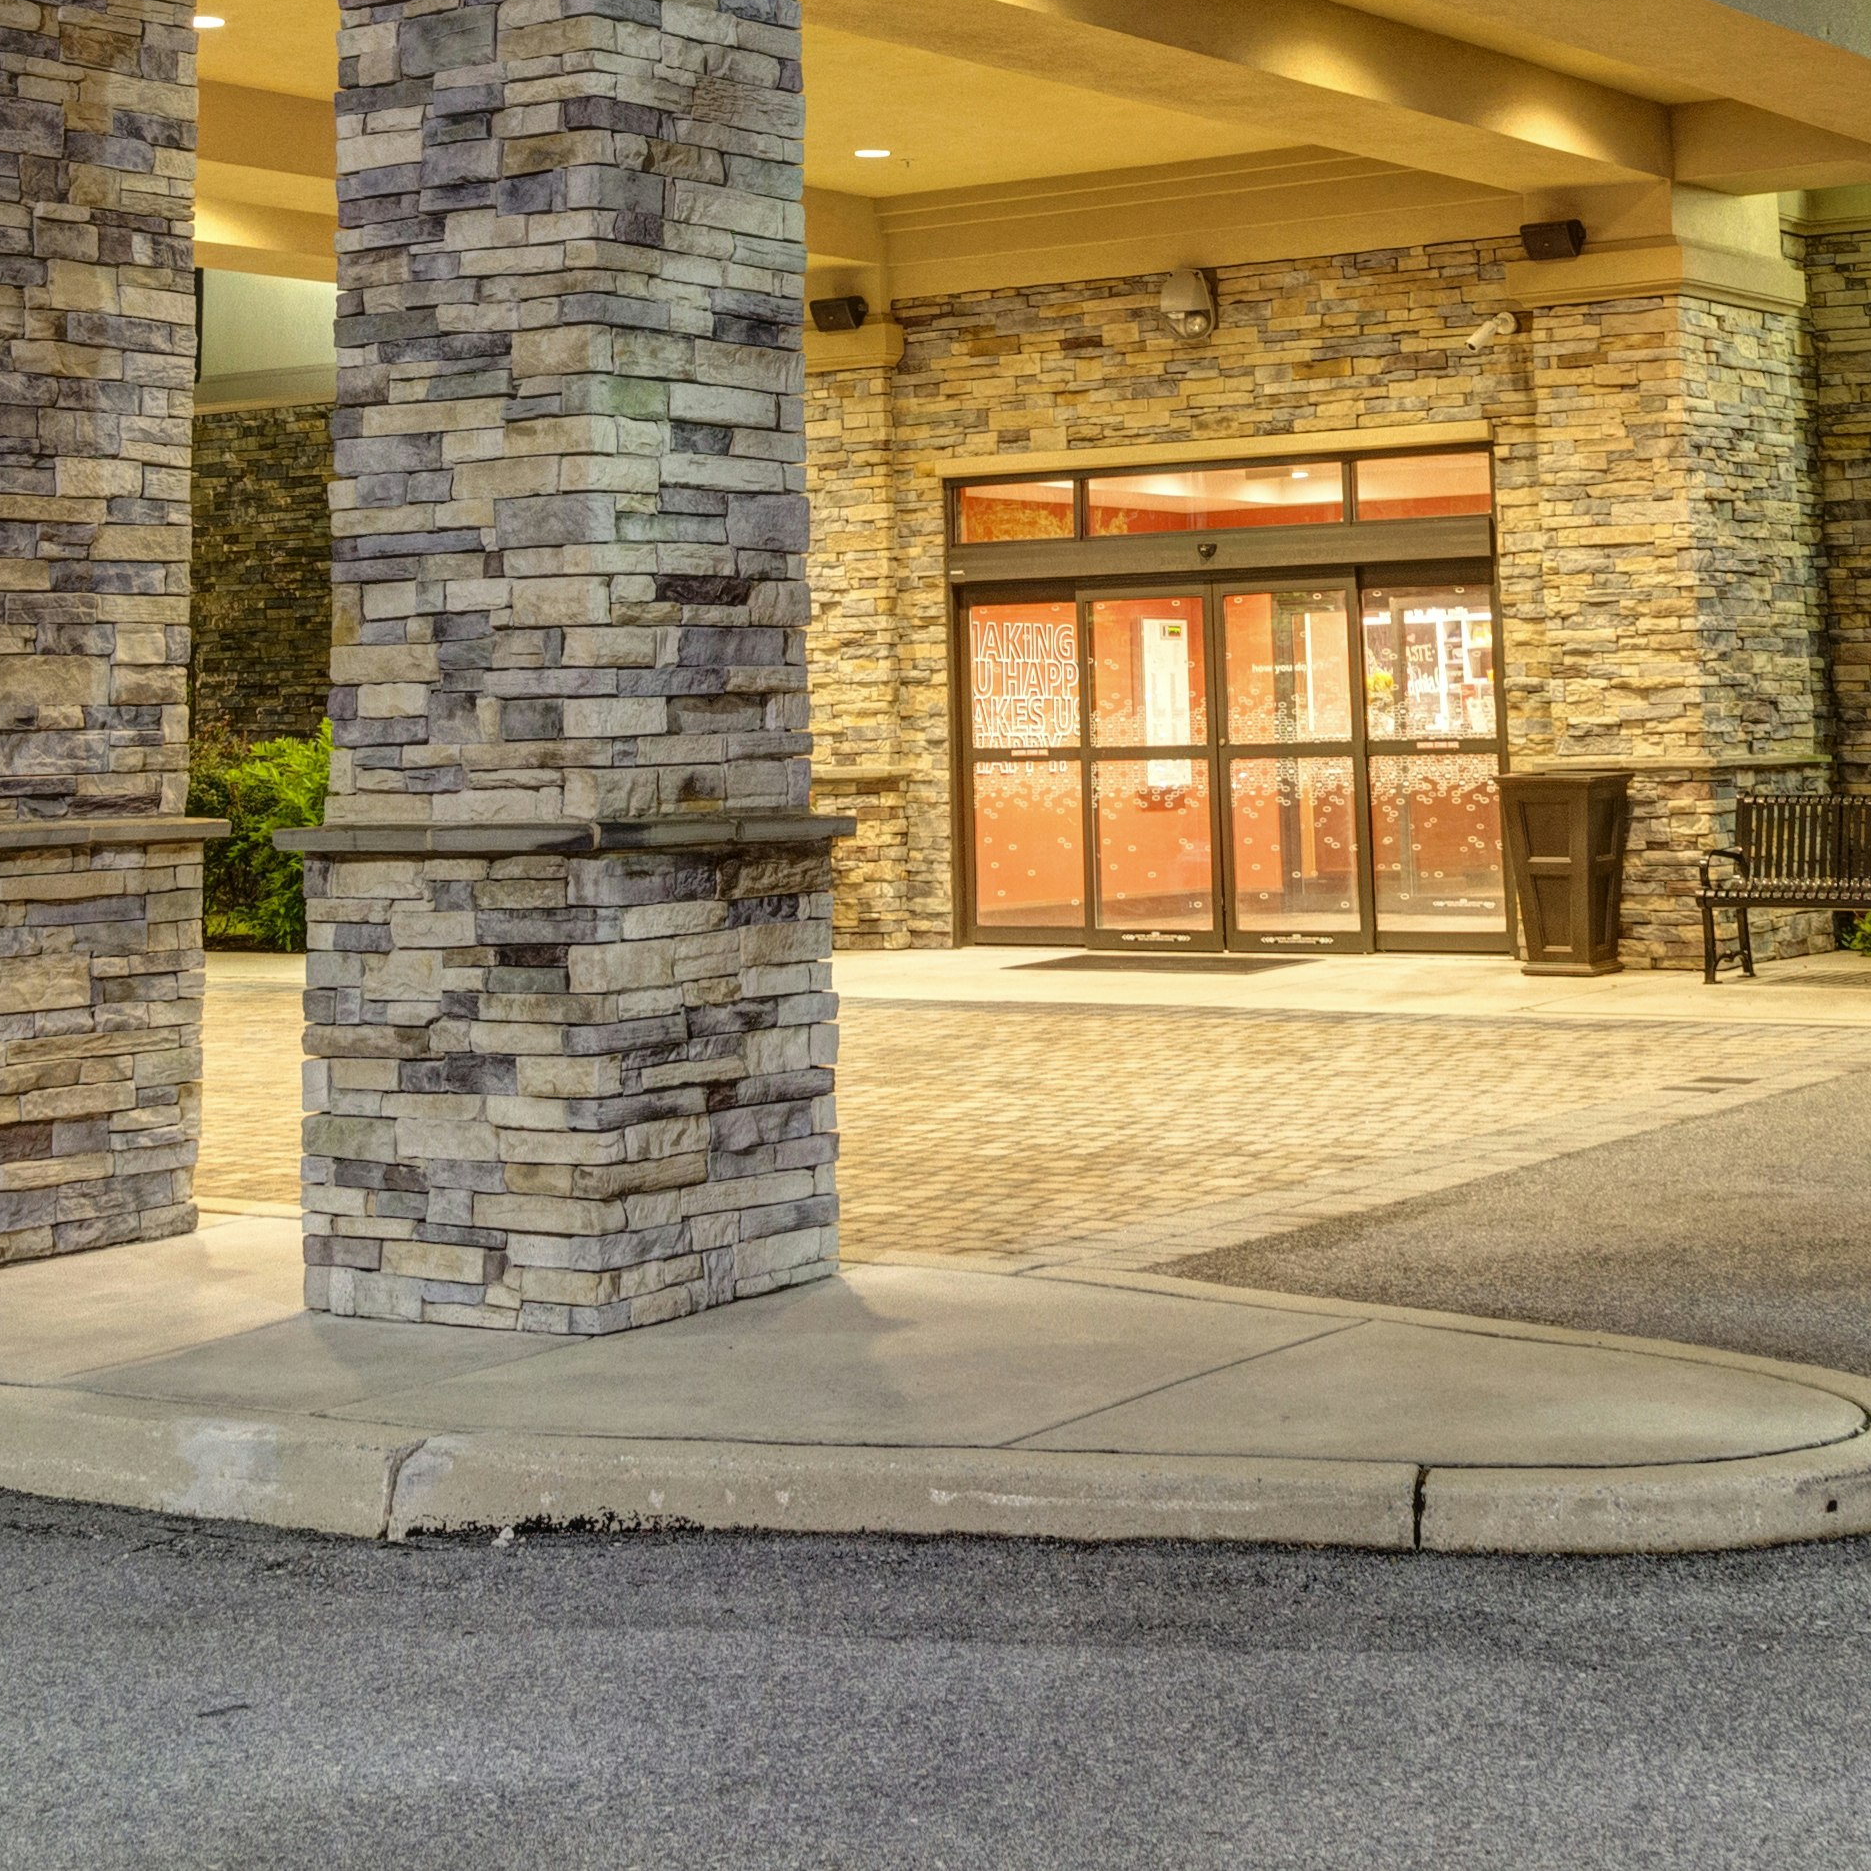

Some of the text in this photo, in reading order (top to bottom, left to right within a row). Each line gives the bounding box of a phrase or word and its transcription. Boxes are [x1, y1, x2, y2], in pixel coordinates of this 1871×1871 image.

[1002, 660, 1080, 699] HAPP
[1275, 664, 1292, 674] you
[973, 696, 1045, 736] AKES
